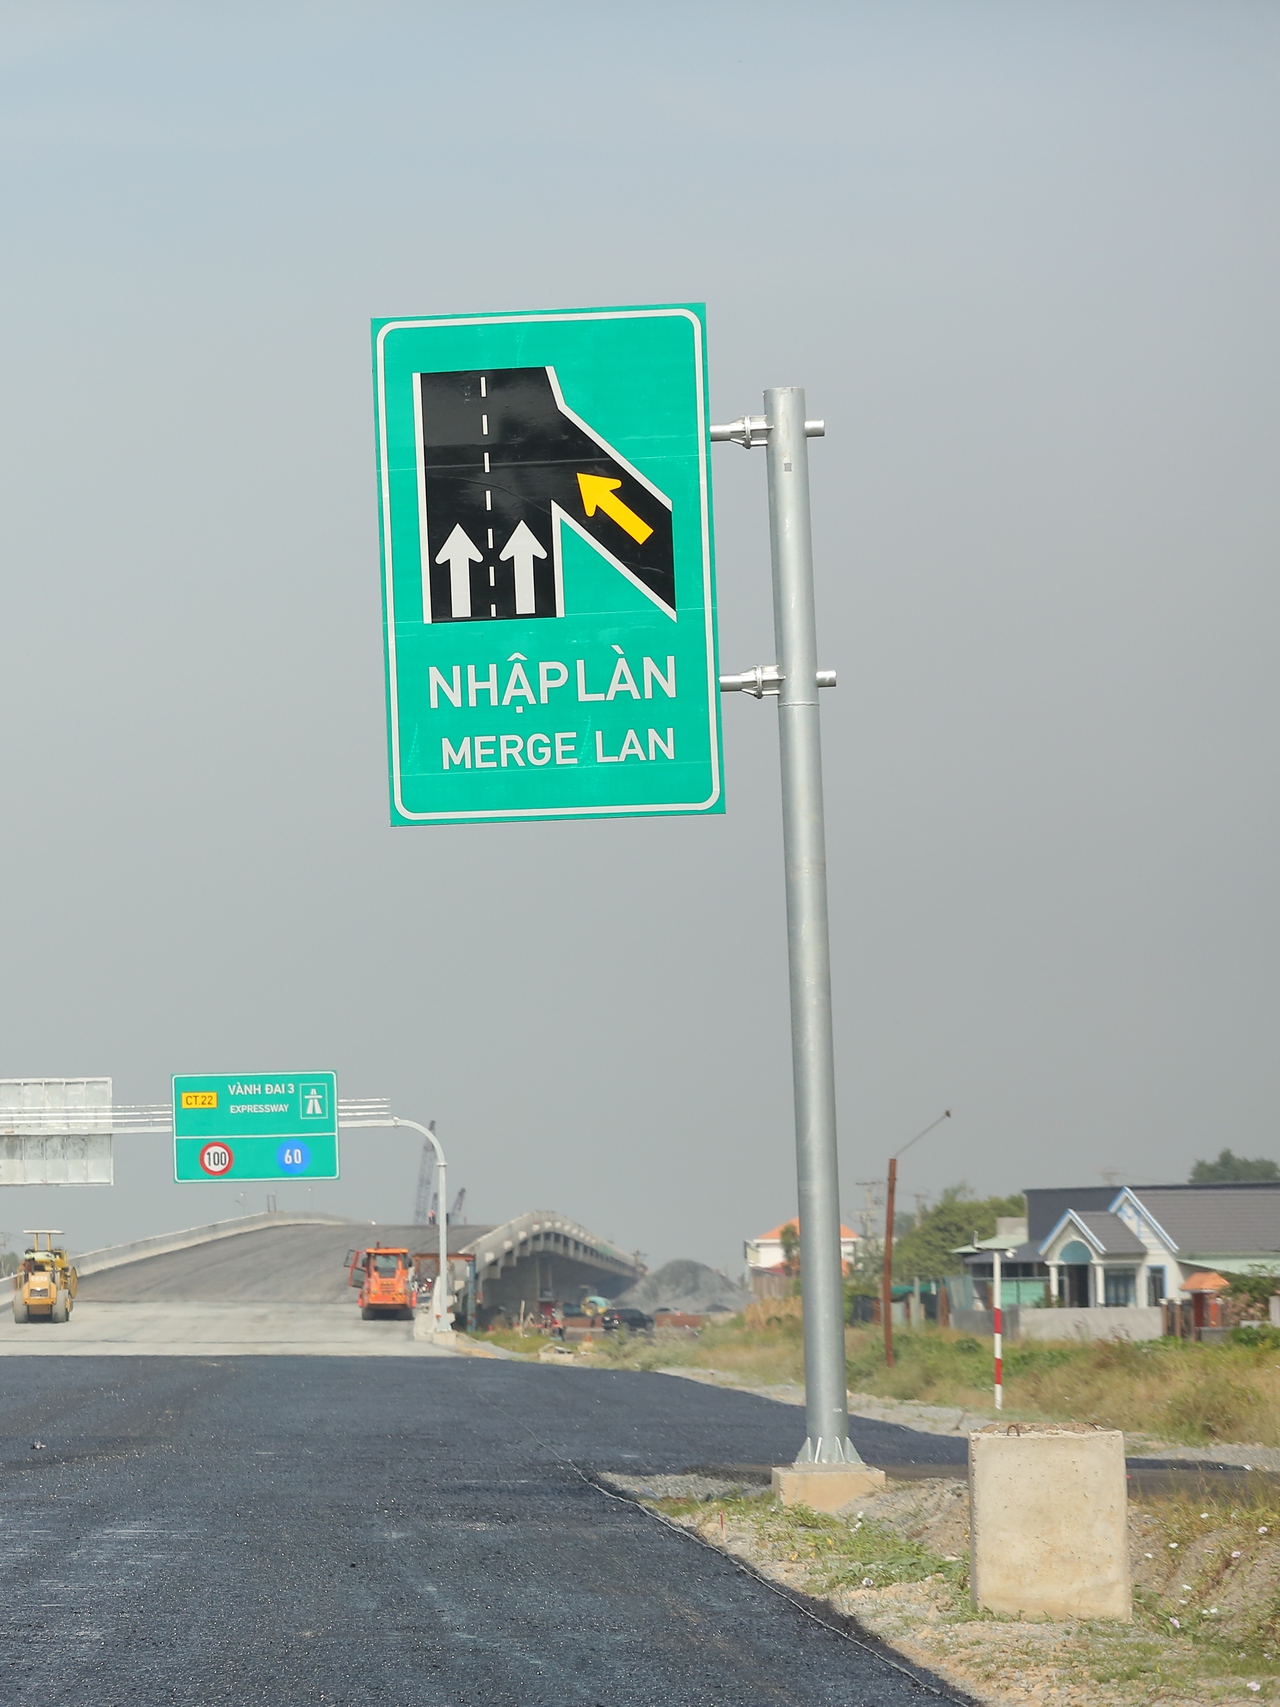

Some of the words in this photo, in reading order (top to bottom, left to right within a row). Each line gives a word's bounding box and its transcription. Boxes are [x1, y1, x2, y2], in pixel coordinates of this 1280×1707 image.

[441, 732, 578, 770] MERGE
[595, 727, 675, 763] LAN
[228, 1082, 262, 1095] VÀNH
[265, 1084, 285, 1094] ĐAI
[288, 1084, 295, 1094] 3
[185, 1095, 213, 1105] CT.22
[230, 1104, 289, 1113] EXPRESSWAY
[206, 1151, 227, 1166] 100
[284, 1149, 302, 1164] 60
